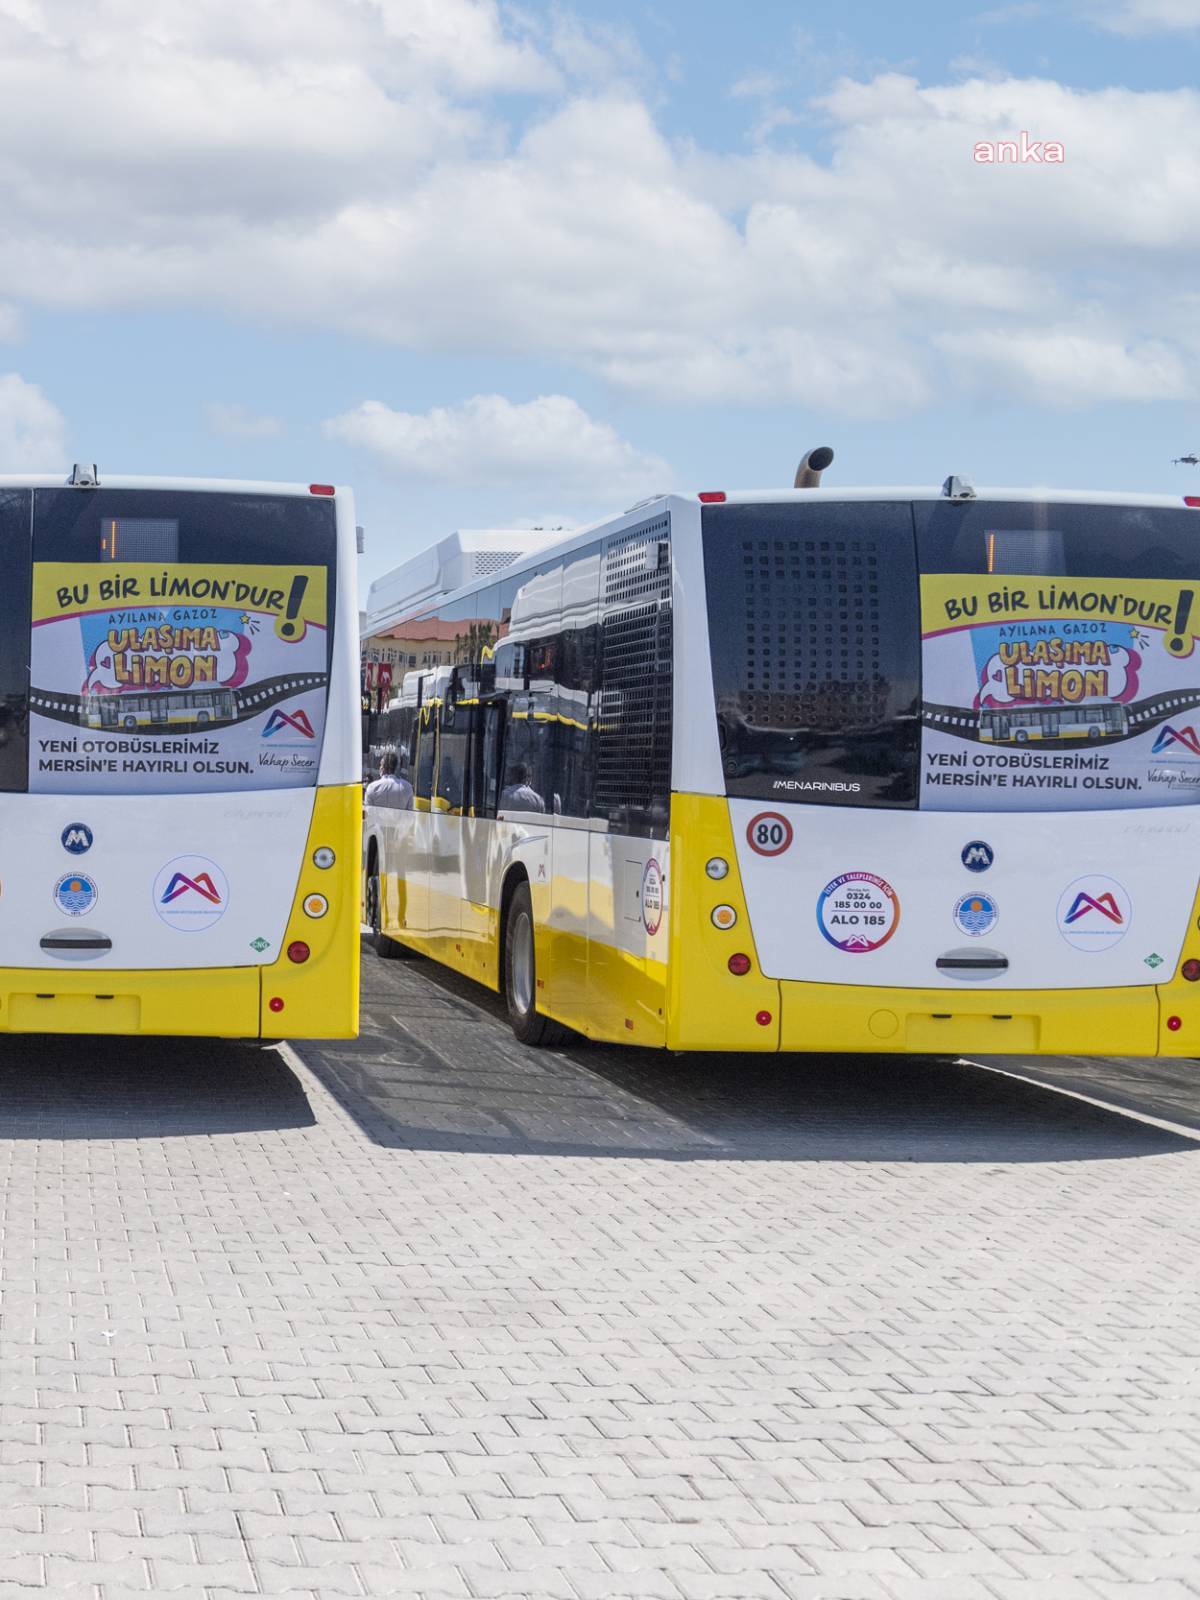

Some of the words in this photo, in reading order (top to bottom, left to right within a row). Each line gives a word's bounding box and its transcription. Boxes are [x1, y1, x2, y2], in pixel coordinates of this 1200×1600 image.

[56, 583, 89, 608] BU
[99, 574, 140, 601] BİR
[944, 596, 977, 621] BU
[988, 586, 1029, 614] BİR
[108, 610, 166, 625] AYILANA
[173, 608, 219, 621] GAZOZ
[106, 623, 222, 655] ULAŞIMA
[999, 624, 1056, 638] AYILANA
[1062, 621, 1107, 634] GAZOZ
[999, 637, 1112, 669] ULAŞIMA
[112, 651, 219, 687] LİMON
[1004, 665, 1109, 701] LİMON
[38, 737, 78, 754] YENİ
[81, 737, 220, 755] OTOBÜSLERİMİZ
[122, 759, 188, 773] HAYIRLI
[193, 760, 254, 774] OLSUN.
[258, 752, 290, 773] Vahap
[927, 751, 968, 767] YENİ
[972, 752, 1109, 770] OTOBÜSLERİMİZ
[1012, 775, 1078, 789] HAYIRLI
[1082, 776, 1142, 790] OLSUN.
[1148, 769, 1177, 790] Vahap
[757, 823, 783, 845] 80
[834, 901, 851, 909] 185
[853, 901, 866, 909] 00
[846, 892, 871, 900] 0324
[830, 915, 859, 925] ALO
[863, 916, 886, 926] 185
